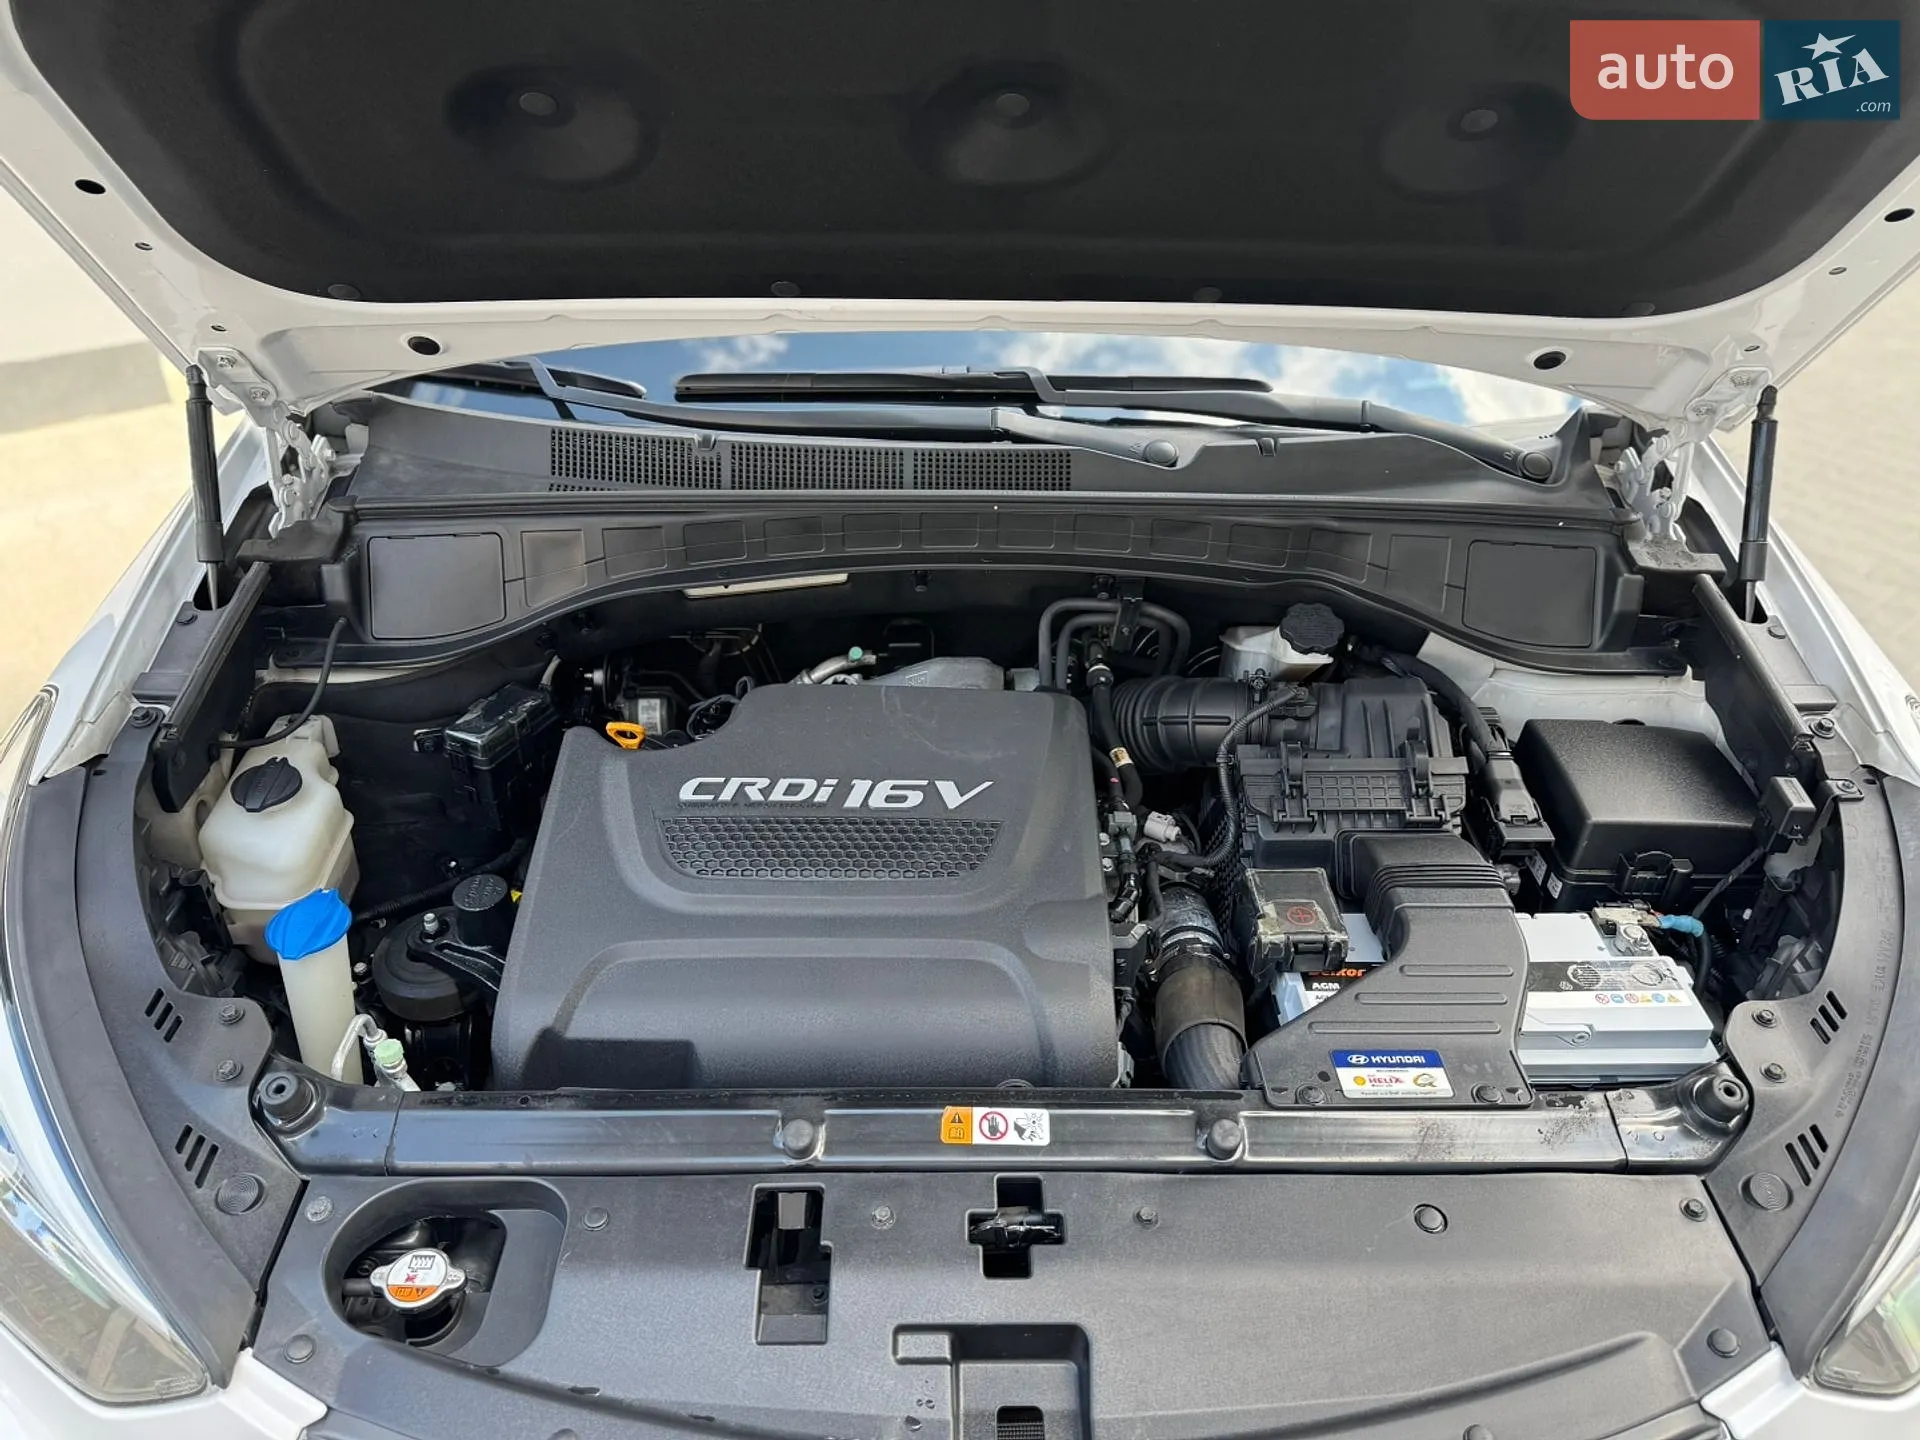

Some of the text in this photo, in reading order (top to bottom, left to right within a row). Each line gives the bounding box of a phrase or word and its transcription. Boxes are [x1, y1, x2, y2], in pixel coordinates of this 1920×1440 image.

[678, 777, 839, 803] CRDi
[1312, 982, 1340, 990] AGM
[1371, 1055, 1426, 1064] HYUNDAI
